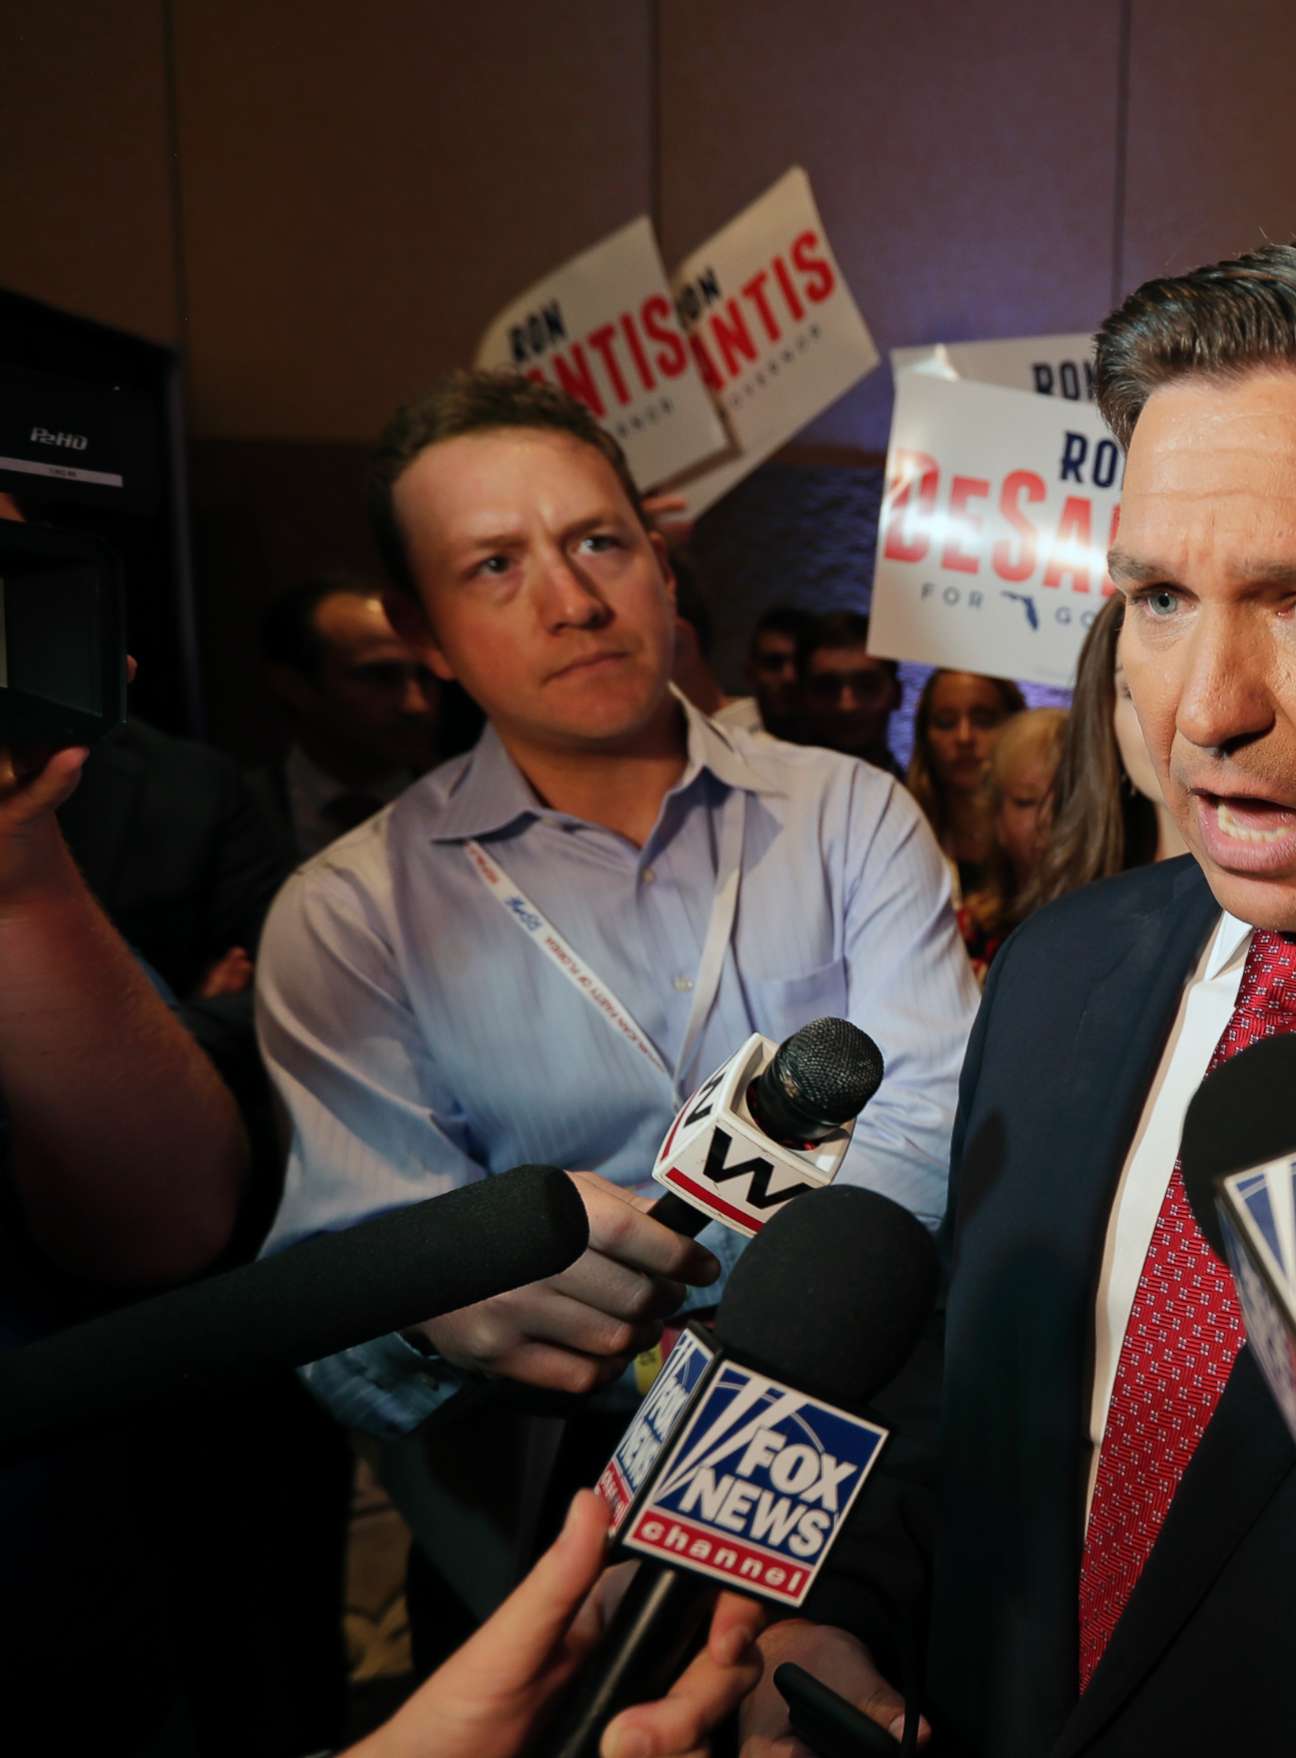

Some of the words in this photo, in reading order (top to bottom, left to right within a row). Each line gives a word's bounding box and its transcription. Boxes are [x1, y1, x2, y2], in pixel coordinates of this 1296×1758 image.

[509, 299, 565, 362] RON
[921, 582, 984, 608] FOR
[735, 1425, 857, 1512] FOX
[677, 1465, 832, 1557] NEWS
[640, 1520, 802, 1592] channel
